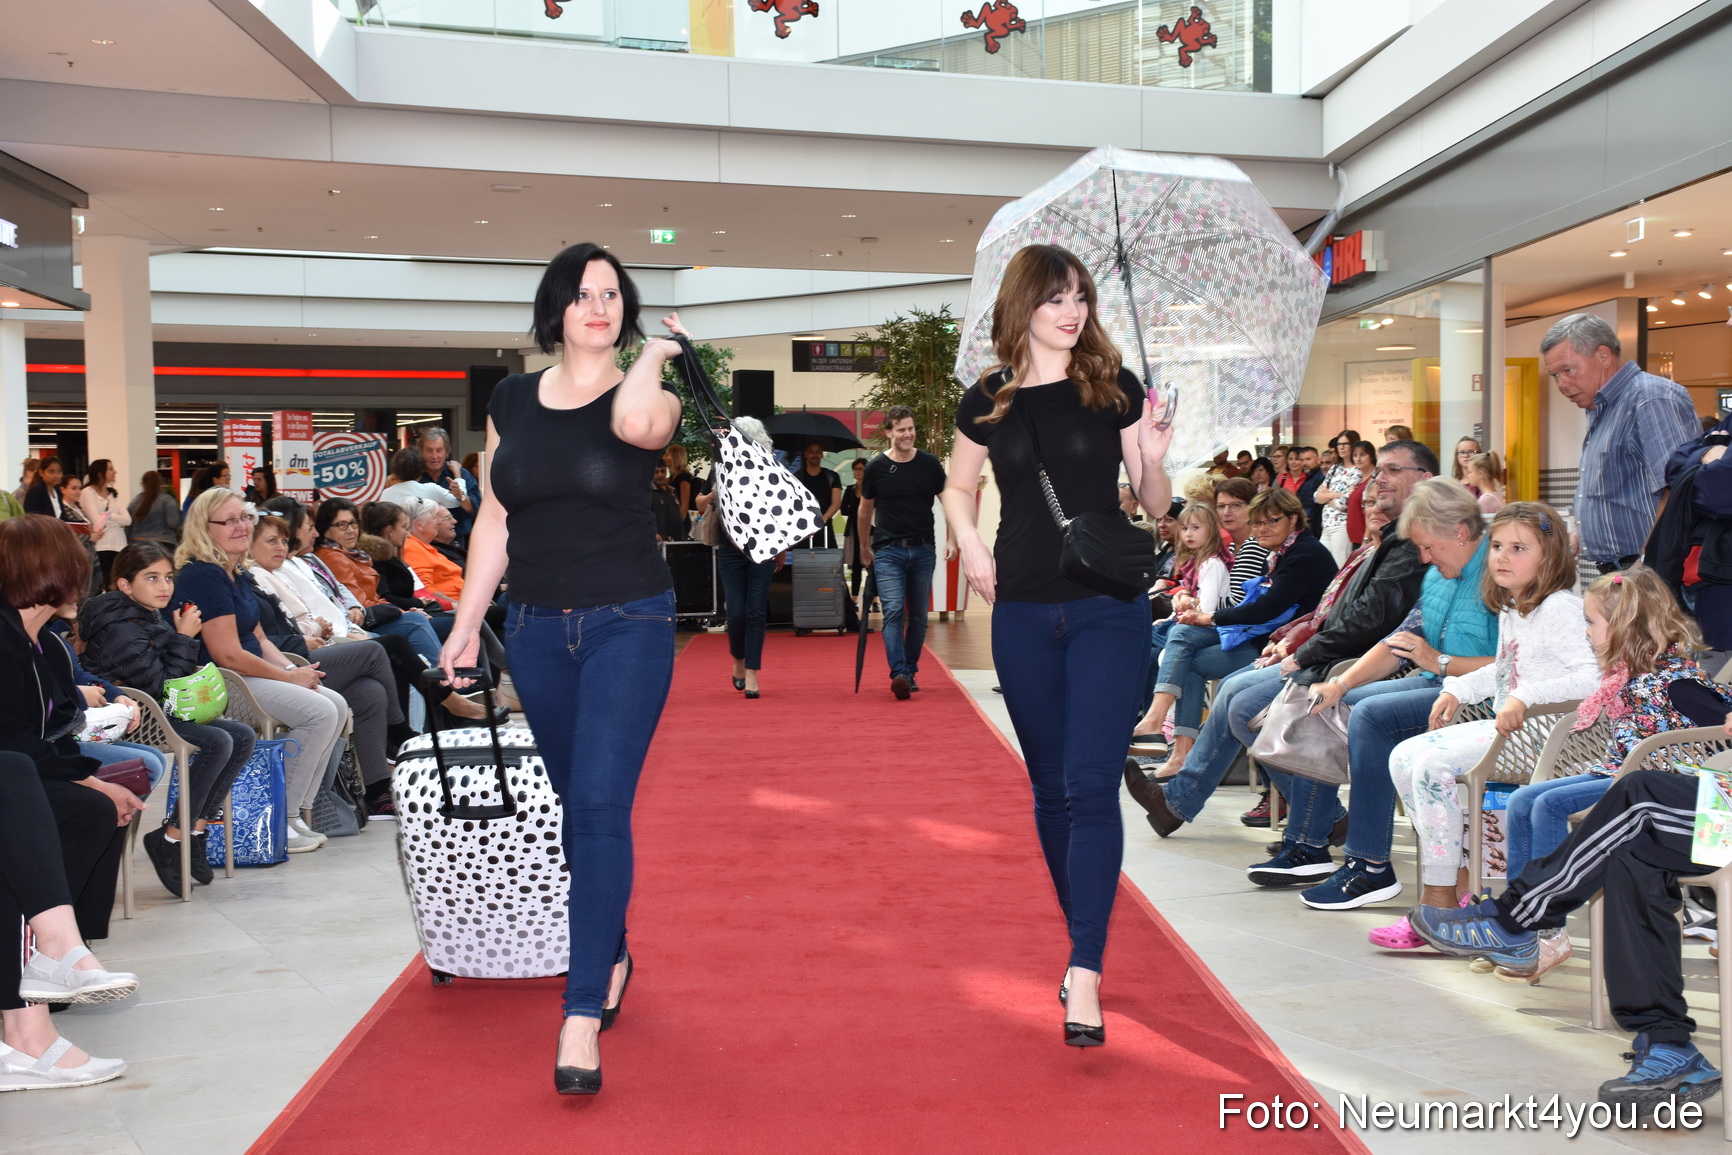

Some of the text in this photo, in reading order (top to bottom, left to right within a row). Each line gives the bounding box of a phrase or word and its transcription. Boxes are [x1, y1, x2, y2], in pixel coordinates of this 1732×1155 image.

[313, 441, 378, 458] TOTALABVERKAUF
[289, 453, 309, 468] dm
[313, 460, 366, 483] -50%
